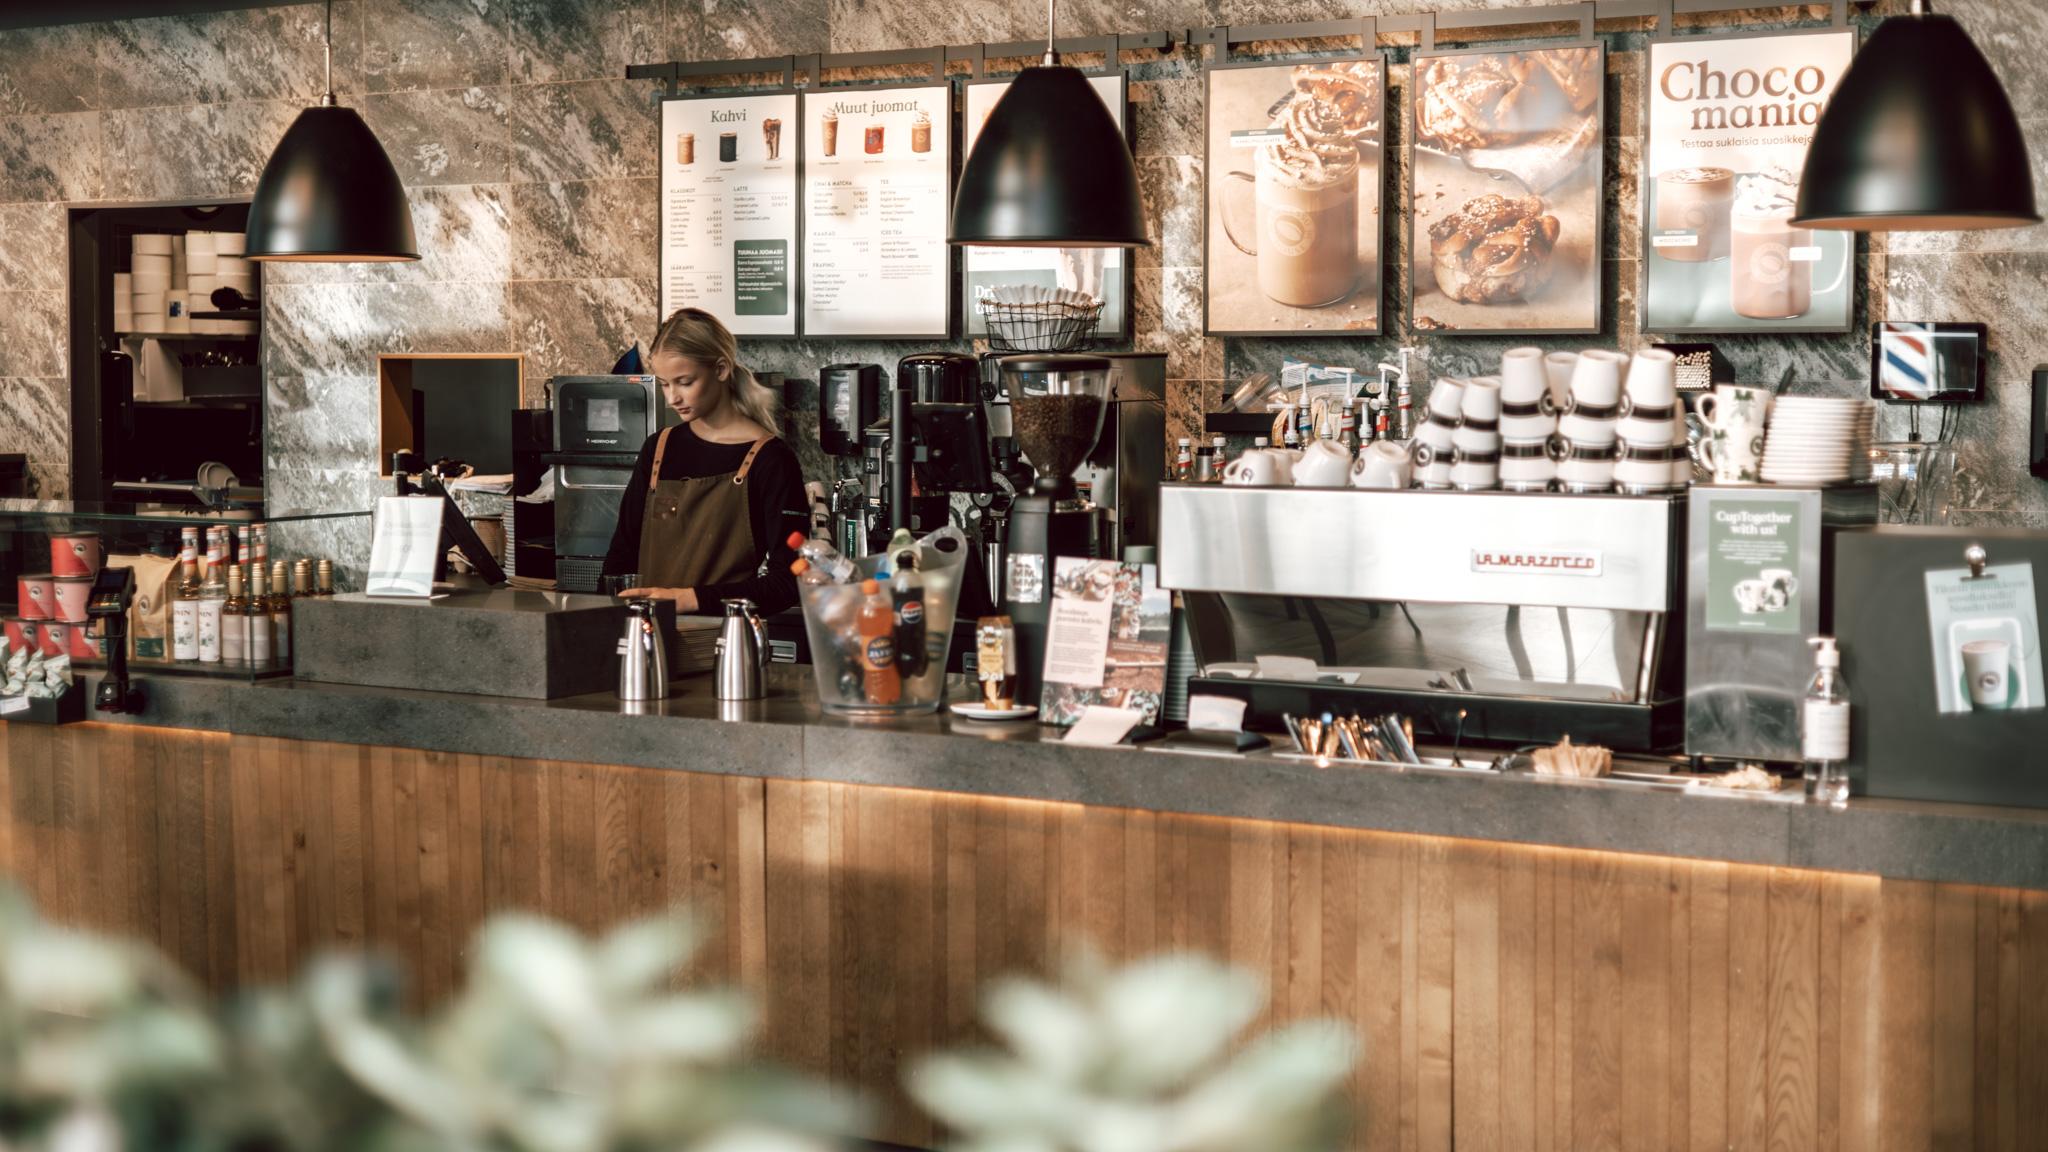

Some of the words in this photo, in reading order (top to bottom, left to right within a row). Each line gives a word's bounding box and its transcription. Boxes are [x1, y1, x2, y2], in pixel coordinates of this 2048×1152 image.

[1660, 60, 1825, 102] Choco
[834, 101, 868, 115] Muut
[870, 100, 919, 117] juomat
[1691, 92, 1824, 130] mania
[710, 109, 747, 123] Kahvi
[1680, 139, 1713, 149] Testaa
[1715, 136, 1759, 147] suklaisia
[1715, 510, 1793, 524] CupTogether
[1730, 524, 1758, 536] with
[1760, 524, 1778, 536] us!
[1499, 554, 1595, 569] MARZOCCO
